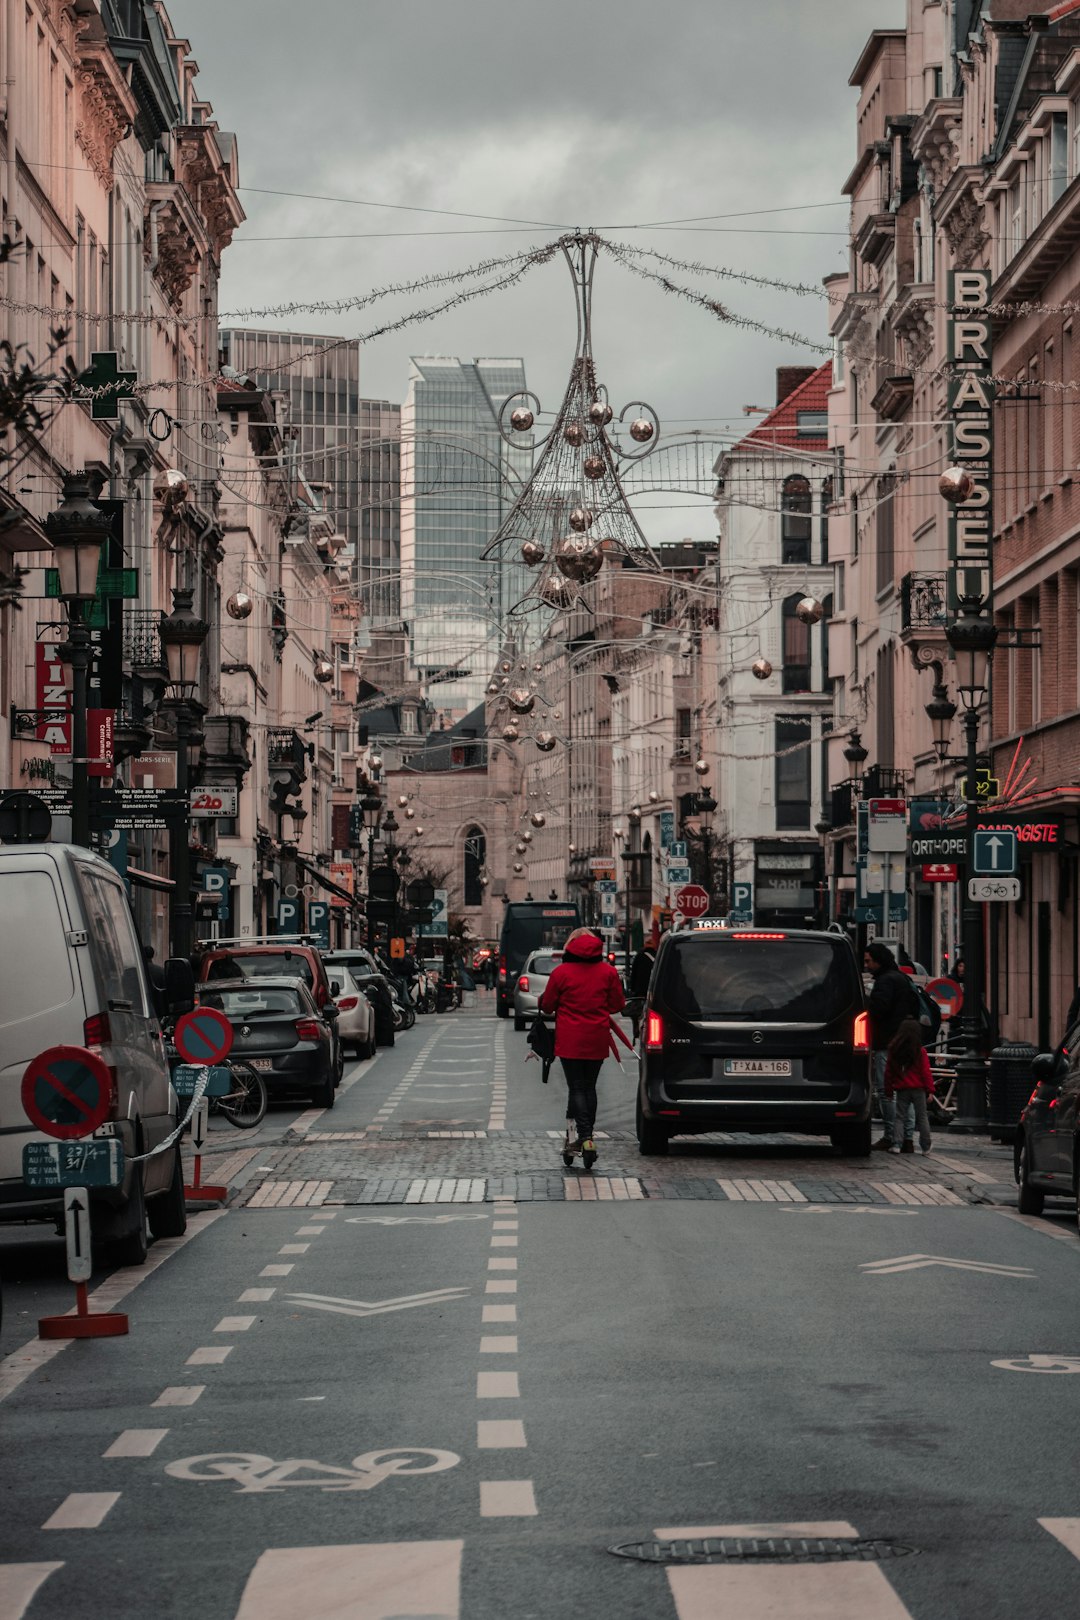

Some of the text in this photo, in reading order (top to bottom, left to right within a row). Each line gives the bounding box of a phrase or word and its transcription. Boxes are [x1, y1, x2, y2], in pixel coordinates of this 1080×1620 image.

[677, 895, 708, 909] STOP
[734, 886, 749, 907] P
[279, 903, 296, 927] P
[310, 905, 326, 927] P
[697, 919, 728, 929] TAXI
